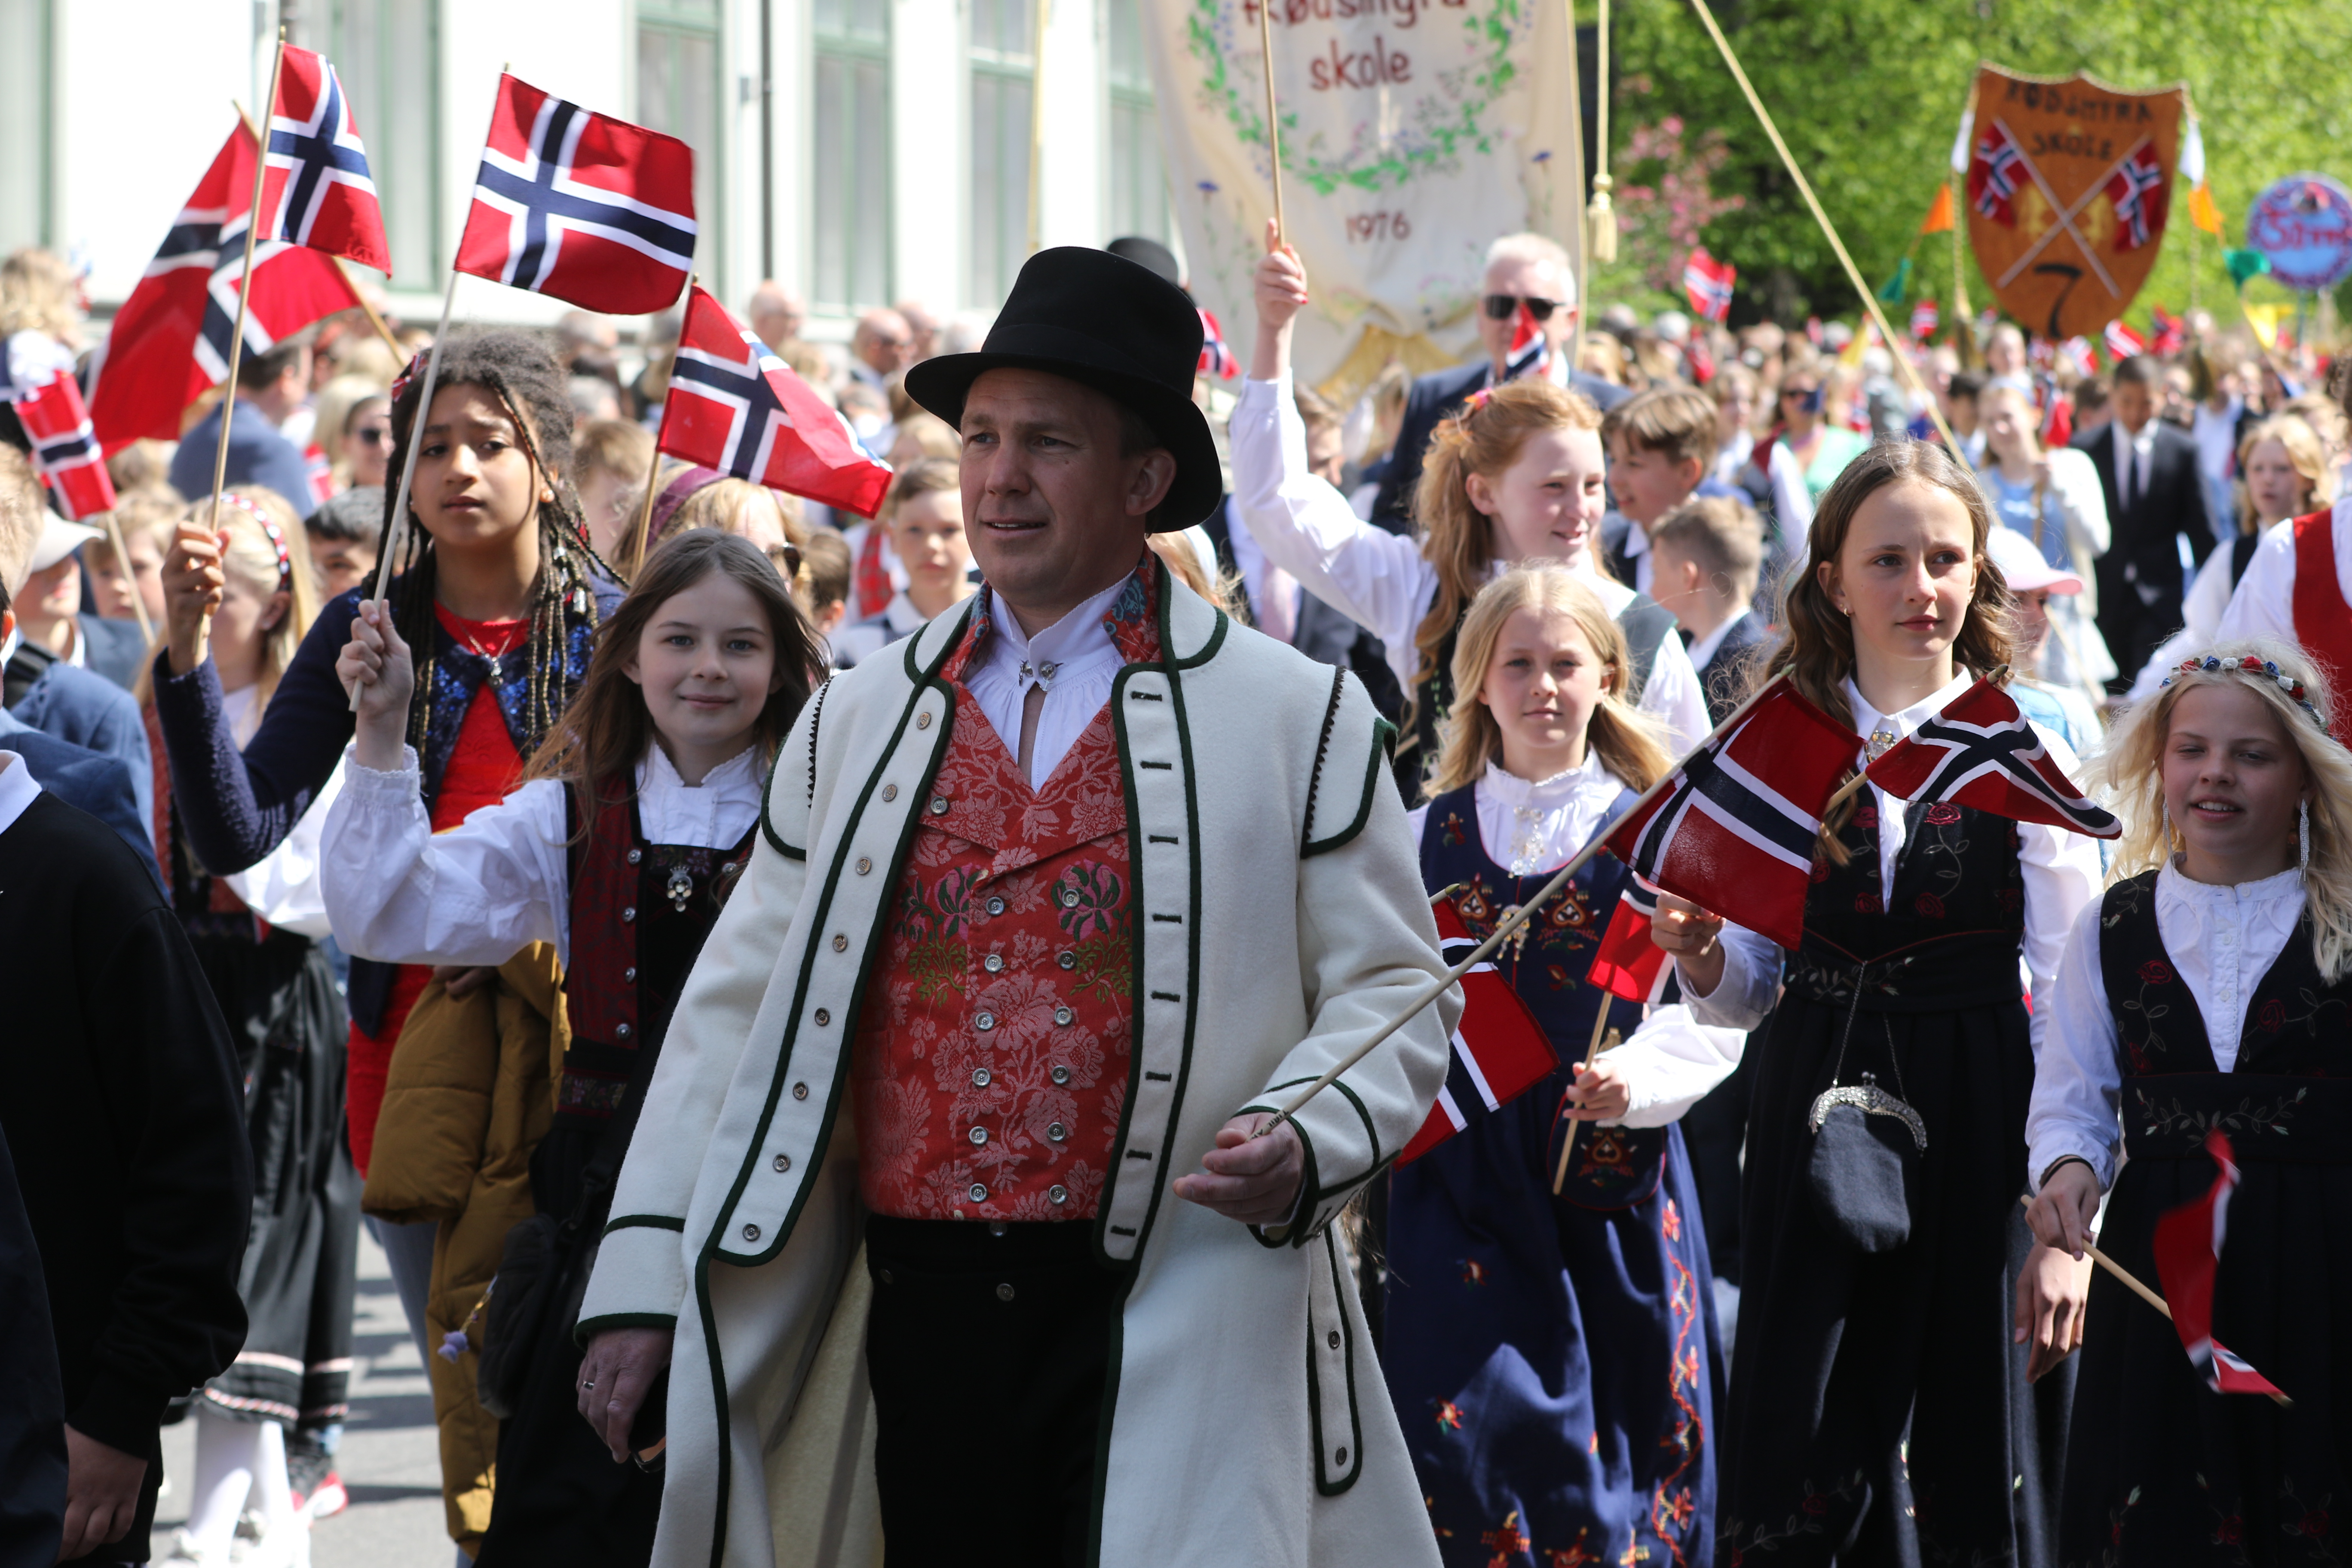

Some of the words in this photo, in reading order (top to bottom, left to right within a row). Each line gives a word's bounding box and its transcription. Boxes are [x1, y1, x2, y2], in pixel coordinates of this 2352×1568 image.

[1310, 35, 1412, 90] skole
[2032, 133, 2113, 160] SKOLE
[1345, 209, 1411, 244] 1976
[2034, 263, 2083, 340] 7
